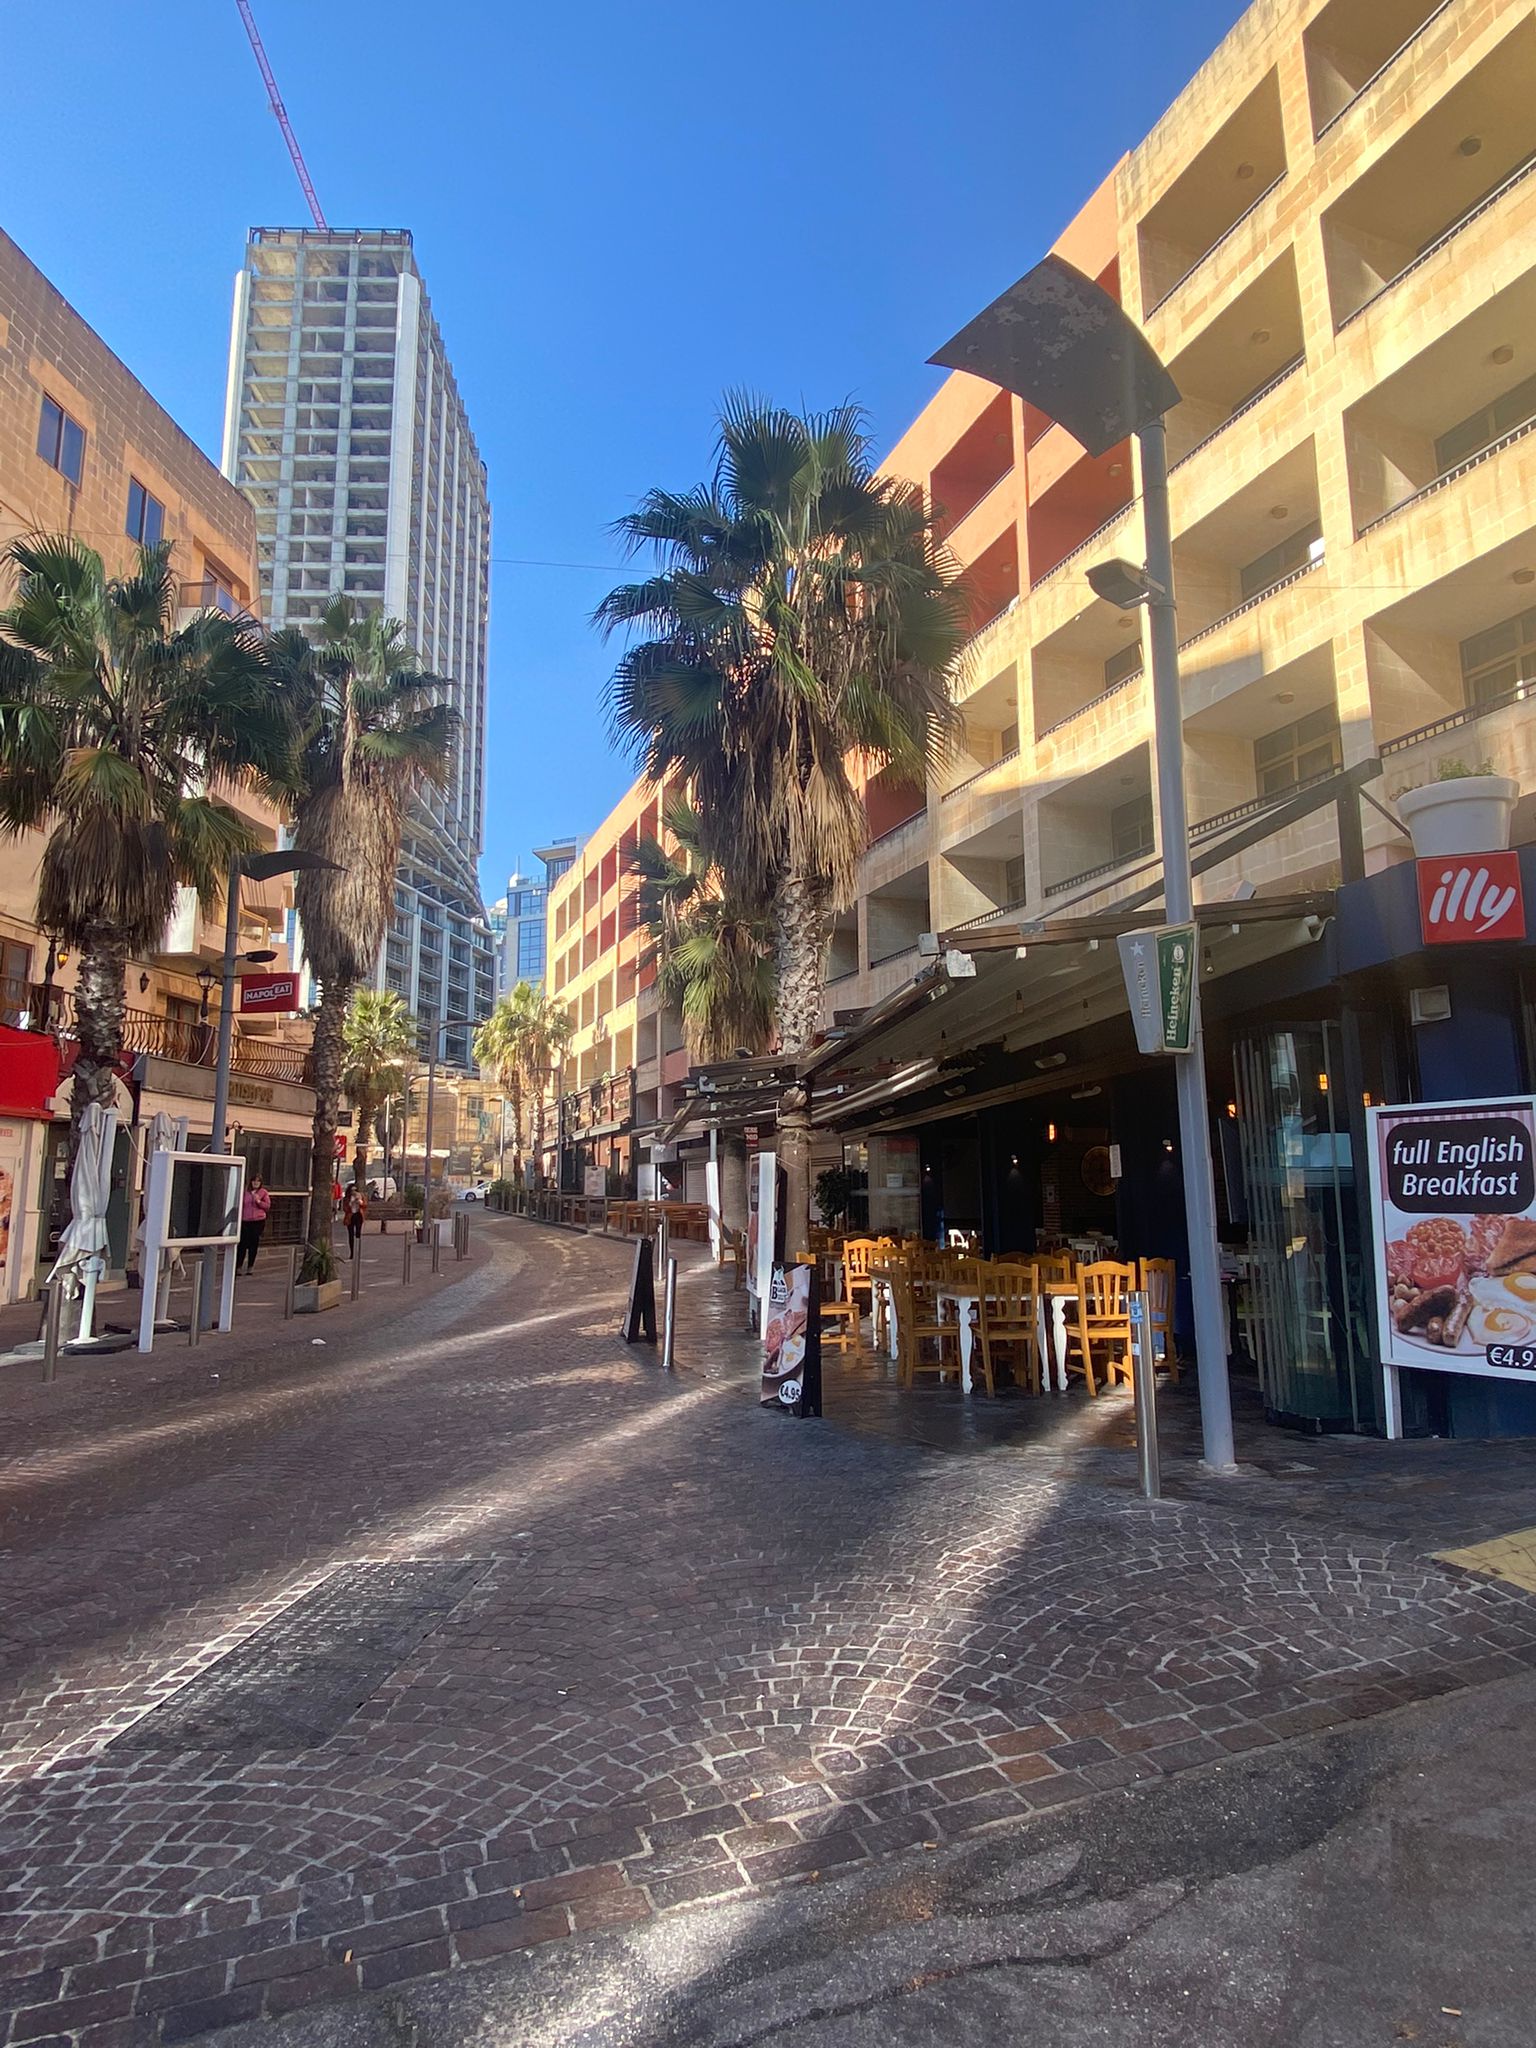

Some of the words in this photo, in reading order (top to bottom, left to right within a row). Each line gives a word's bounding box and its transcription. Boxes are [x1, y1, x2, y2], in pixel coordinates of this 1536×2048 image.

[1428, 867, 1517, 933] illy
[246, 984, 290, 1000] NAPOLEAT
[1138, 960, 1152, 1018] Heineken
[1166, 966, 1183, 1042] Heineken
[1393, 1139, 1431, 1165] full
[1437, 1135, 1524, 1169] English
[1402, 1170, 1519, 1196] Breakfast
[1490, 1346, 1536, 1368] €4.9
